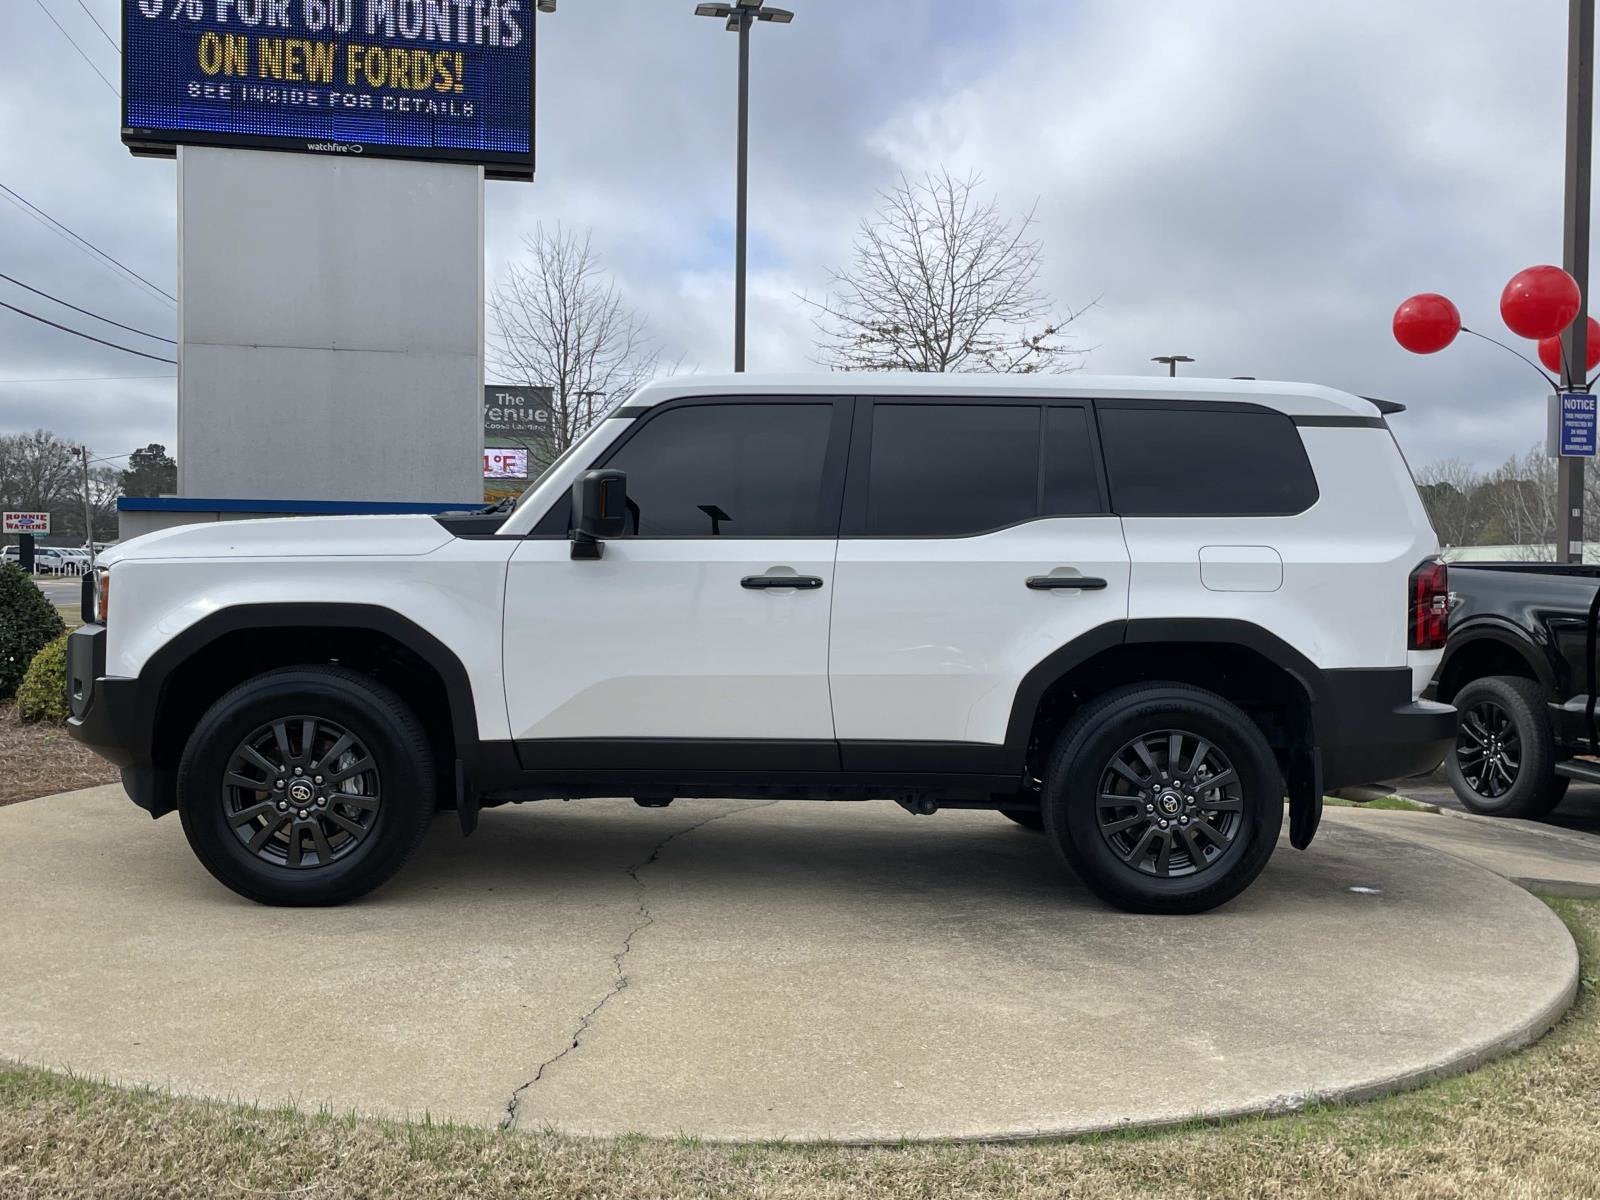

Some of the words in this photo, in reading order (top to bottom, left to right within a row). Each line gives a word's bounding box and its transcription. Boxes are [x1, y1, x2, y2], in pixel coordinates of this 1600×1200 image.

[366, 0, 523, 47] MONTHS
[198, 31, 248, 77] ON
[258, 37, 336, 83] NEW
[346, 44, 465, 94] FORDS!
[187, 81, 231, 99] SEE
[242, 85, 318, 106] INSIDE
[329, 92, 373, 108] FOR
[383, 96, 474, 117] DETAILS
[307, 142, 348, 153] watchfire
[495, 393, 525, 406] The
[1564, 399, 1595, 410] NOTICE
